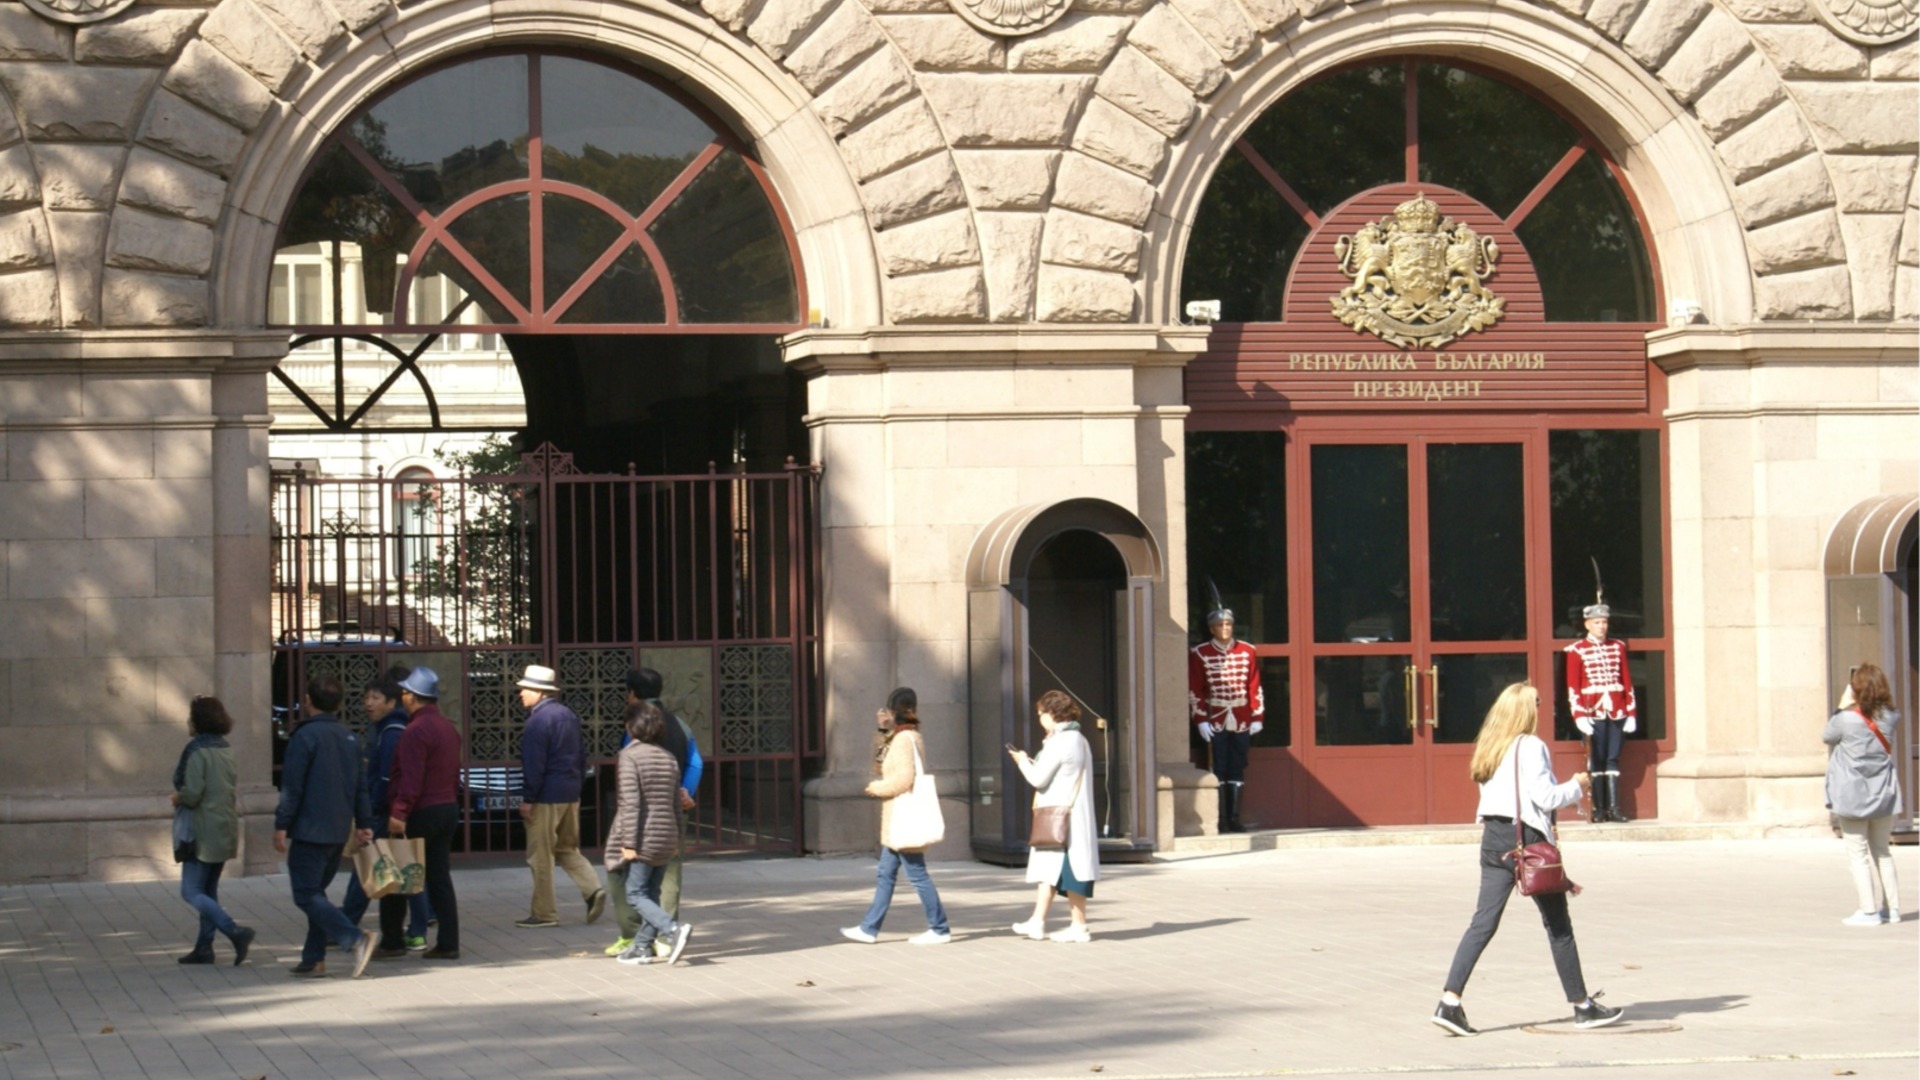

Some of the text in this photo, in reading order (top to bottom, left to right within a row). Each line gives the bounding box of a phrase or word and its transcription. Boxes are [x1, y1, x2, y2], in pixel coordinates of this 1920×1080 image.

[1288, 352, 1545, 370] РЕПУБЛИКА БЪЛГАРИЯ
[1353, 380, 1483, 402] ПРЕЗИДЕНТ
